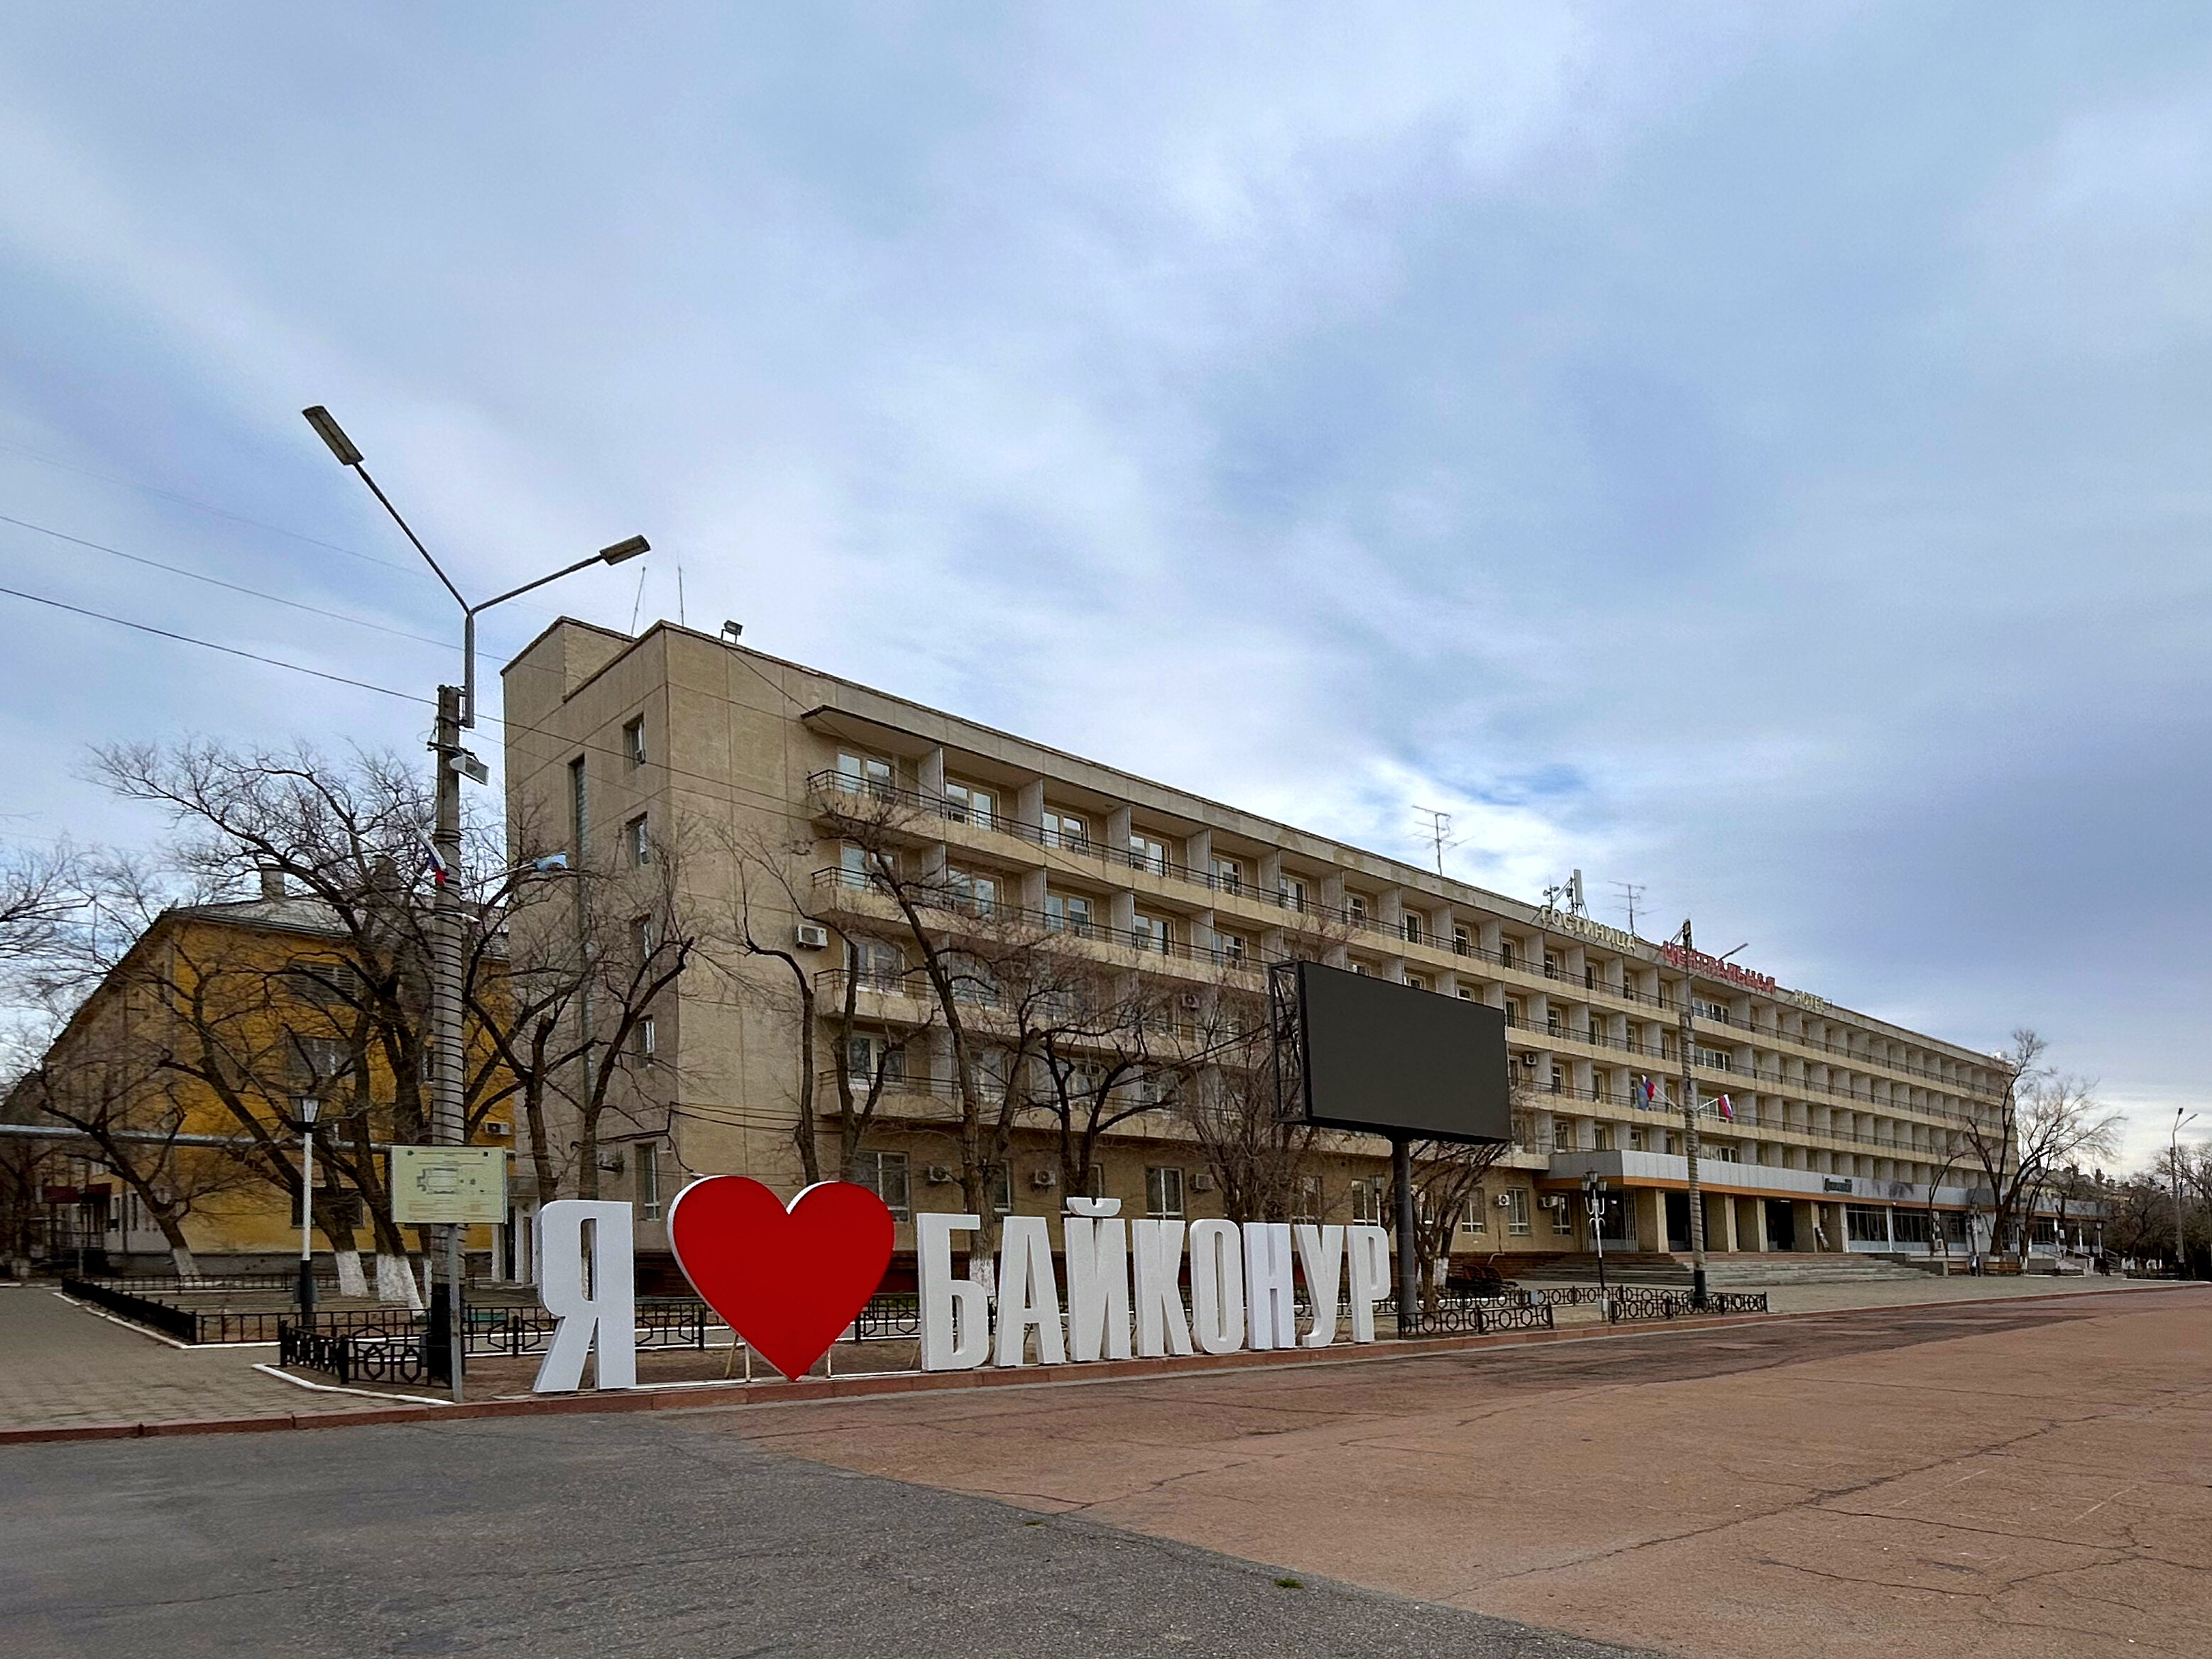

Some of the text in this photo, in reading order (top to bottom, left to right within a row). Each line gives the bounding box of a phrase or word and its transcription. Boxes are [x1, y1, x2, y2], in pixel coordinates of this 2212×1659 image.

[1540, 906, 1775, 994] ГОСТИНИЦА ЦЕНТРАЛЬНАЯ
[1794, 989, 1825, 1011] HOTEL
[533, 1197, 1391, 1393] Я БАЙКОНУР
